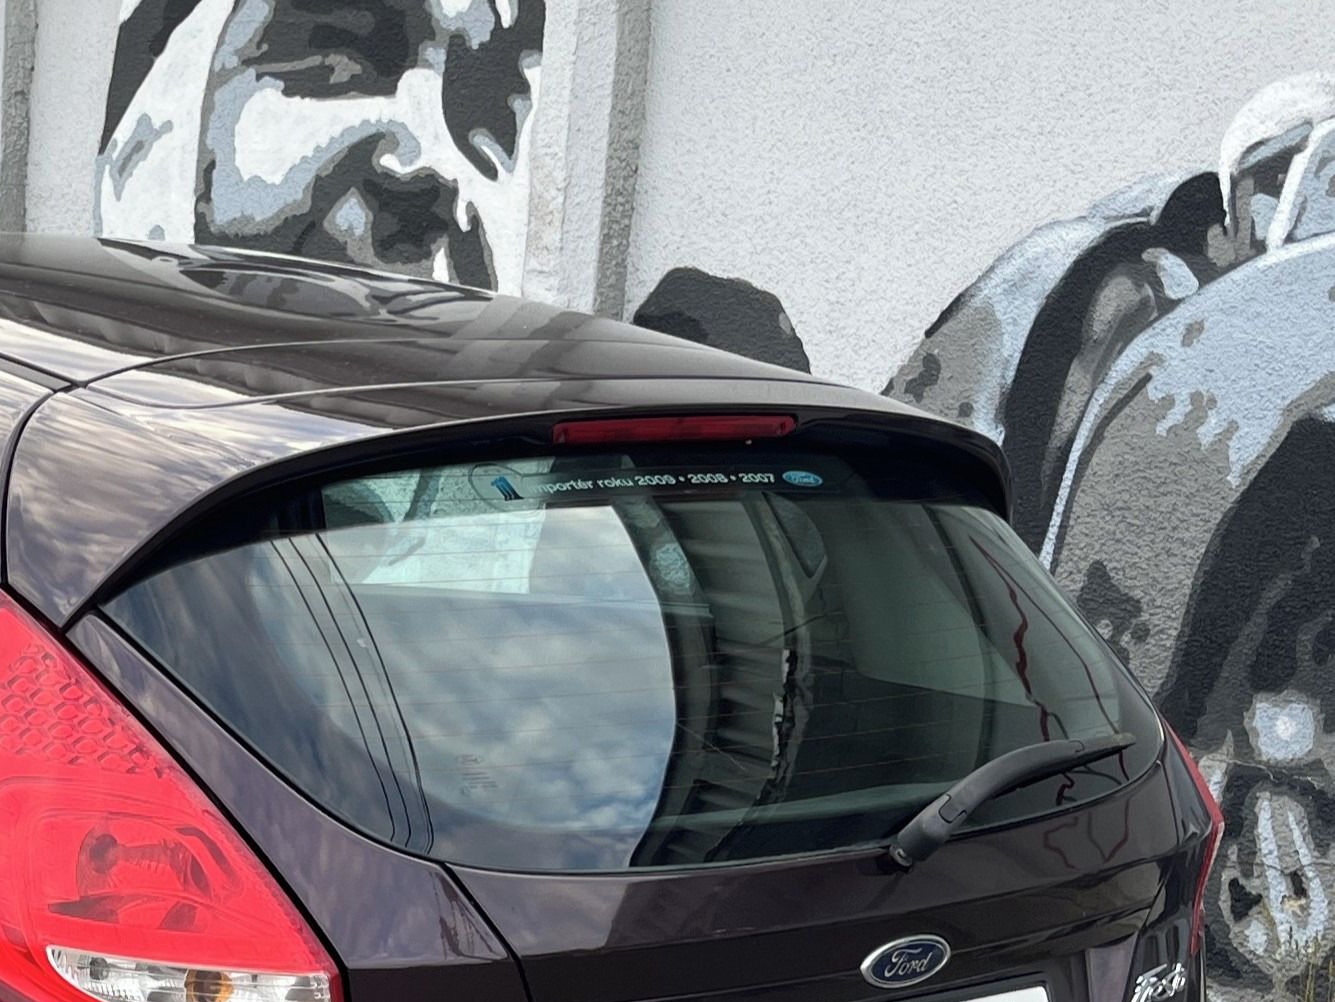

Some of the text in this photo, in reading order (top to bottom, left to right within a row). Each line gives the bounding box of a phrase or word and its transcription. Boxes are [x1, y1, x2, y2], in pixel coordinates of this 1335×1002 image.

[528, 472, 776, 494] mportér roku 2009 2008 2007
